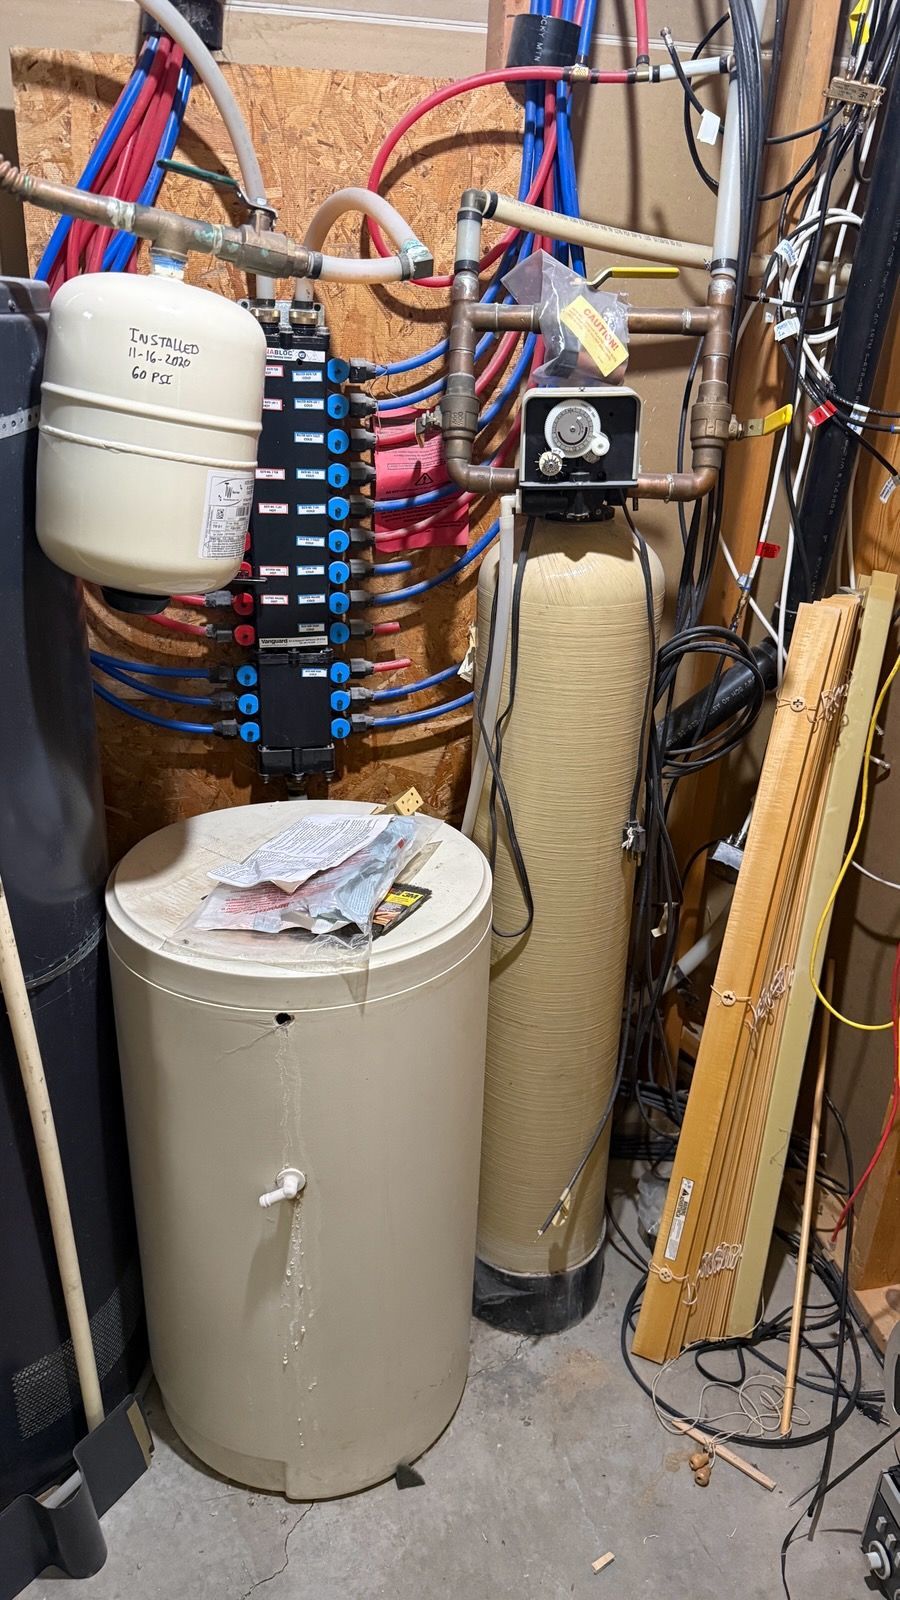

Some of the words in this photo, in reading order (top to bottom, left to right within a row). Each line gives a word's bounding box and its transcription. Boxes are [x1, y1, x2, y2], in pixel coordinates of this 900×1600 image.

[534, 42, 544, 62] MTN
[583, 308, 619, 351] CAUTION!
[129, 327, 200, 355] INSTALLED
[128, 347, 191, 369] 11-16-2020
[131, 366, 147, 380] 60
[151, 372, 173, 385] PSI
